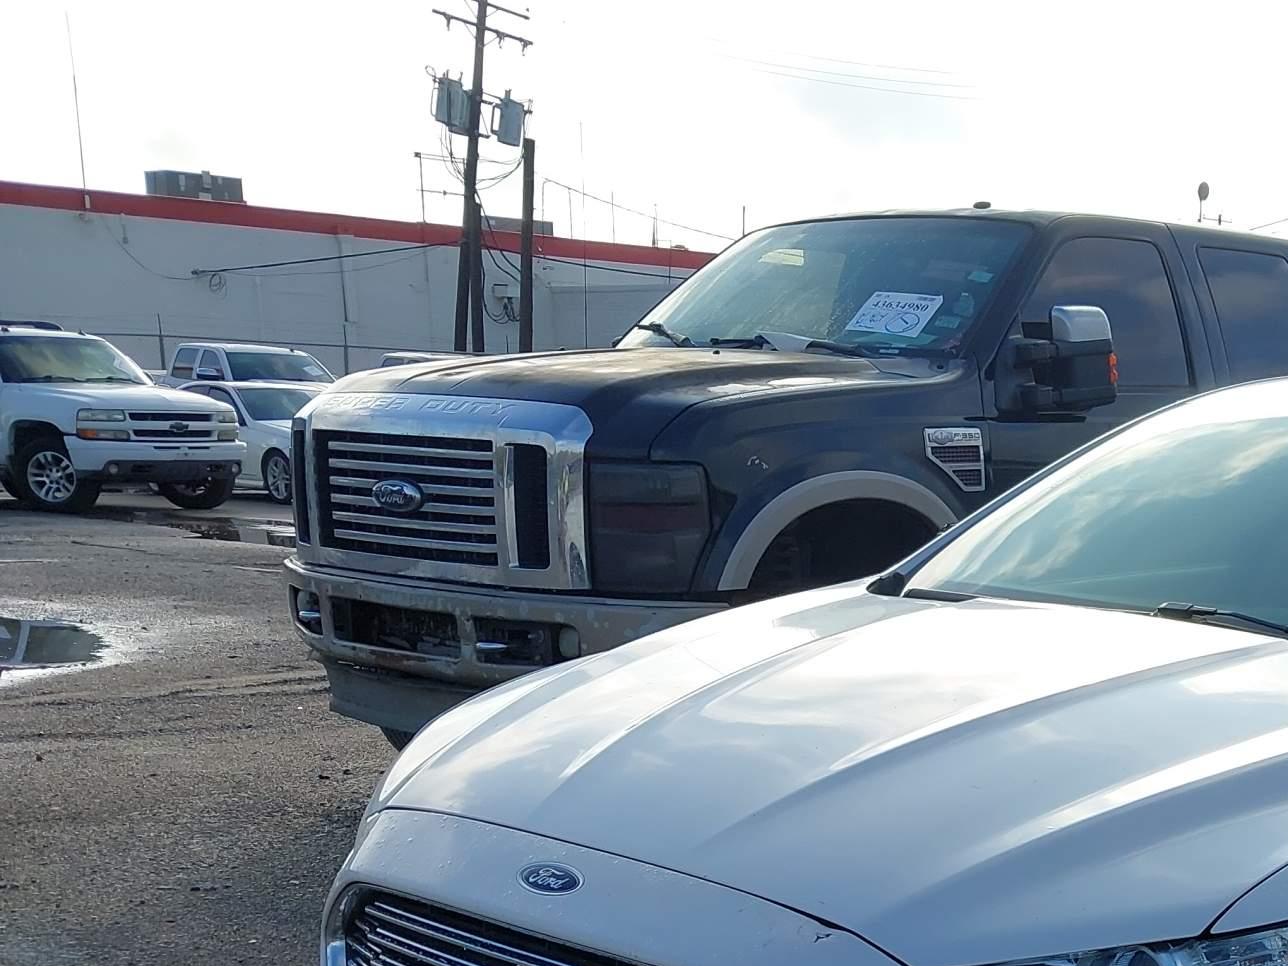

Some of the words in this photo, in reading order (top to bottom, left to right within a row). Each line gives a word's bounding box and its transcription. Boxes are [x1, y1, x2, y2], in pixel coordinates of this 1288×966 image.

[871, 299, 930, 313] 43634980
[418, 398, 515, 416] DUTY
[528, 867, 570, 889] Ford
